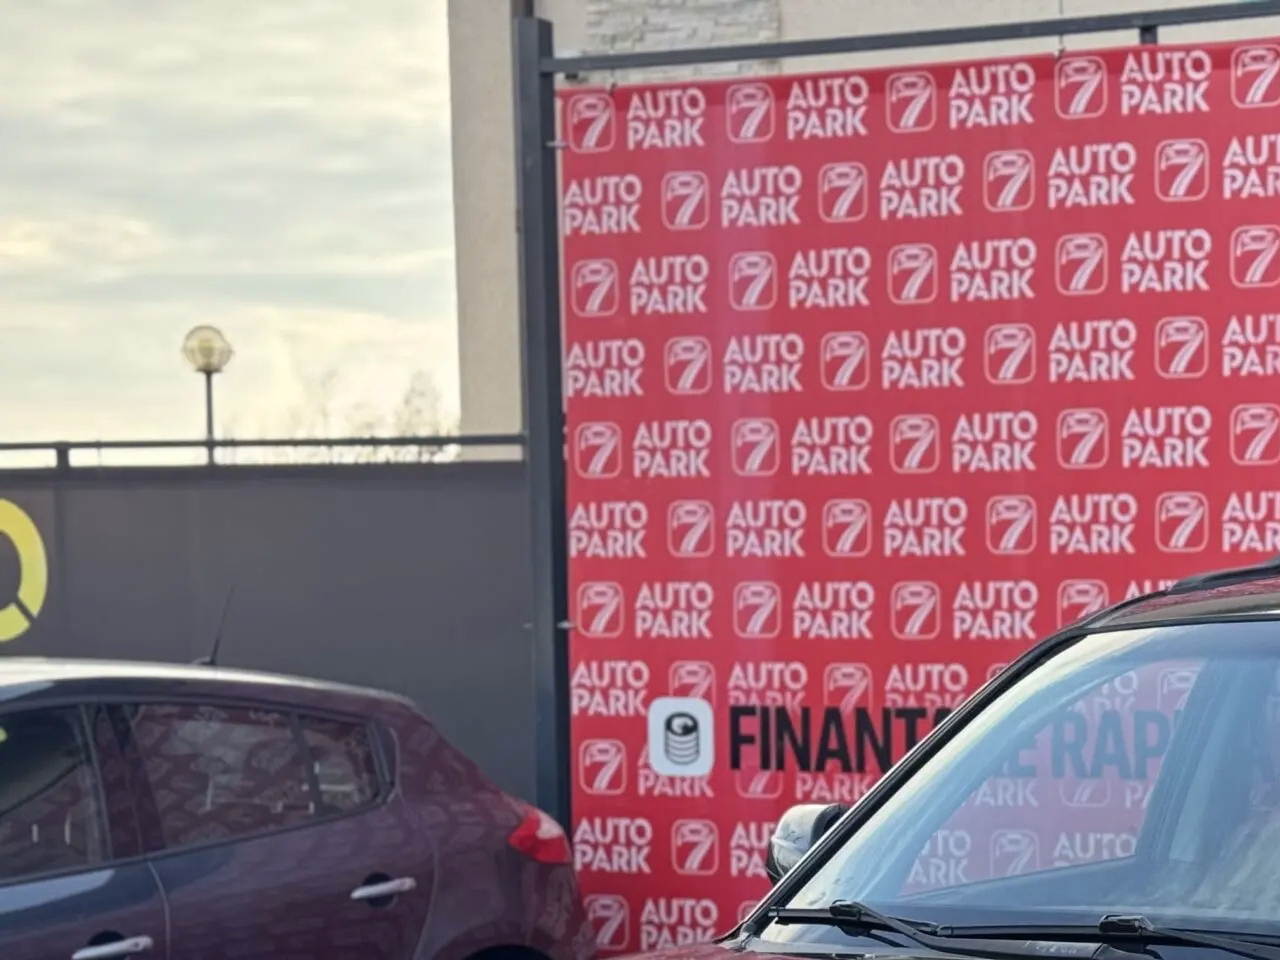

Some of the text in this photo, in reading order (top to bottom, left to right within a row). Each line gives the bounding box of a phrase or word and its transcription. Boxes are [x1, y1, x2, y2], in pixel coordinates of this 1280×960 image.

[948, 63, 1035, 99] AUTO
[1120, 50, 1211, 83] AUTO
[627, 88, 706, 121] AUTO
[786, 76, 868, 111] AUTO
[1121, 80, 1209, 115] PARK
[787, 105, 867, 140] PARK
[950, 92, 1033, 129] PARK
[628, 116, 704, 150] PARK
[880, 155, 964, 191] AUTO
[1048, 142, 1136, 177] AUTO
[564, 175, 642, 206] AUTO
[721, 165, 802, 199] AUTO
[1048, 174, 1134, 208] PARK
[722, 194, 800, 228] PARK
[880, 185, 962, 220] PARK
[564, 205, 640, 234] PARK
[950, 238, 1036, 273] AUTO
[1121, 229, 1211, 261] AUTO
[630, 254, 708, 286] AUTO
[789, 247, 871, 280] AUTO
[1122, 260, 1209, 293] PARK
[631, 284, 706, 314] PARK
[789, 277, 869, 308] PARK
[951, 268, 1034, 302] PARK
[723, 333, 804, 364] AUTO
[882, 327, 966, 361] AUTO
[1049, 319, 1136, 352] AUTO
[566, 338, 645, 369] AUTO
[1050, 350, 1134, 382] PARK
[566, 368, 643, 397] PARK
[724, 362, 802, 393] PARK
[882, 357, 964, 389] PARK
[633, 420, 711, 450] AUTO
[791, 416, 873, 447] AUTO
[952, 411, 1037, 444] AUTO
[1122, 406, 1211, 438] AUTO
[634, 448, 710, 477] PARK
[792, 445, 871, 475] PARK
[953, 441, 1035, 472] PARK
[1122, 437, 1209, 468] PARK
[568, 501, 648, 530] AUTO
[726, 499, 806, 529] AUTO
[884, 497, 967, 528] AUTO
[1050, 493, 1137, 525] AUTO
[569, 529, 646, 559] PARK
[727, 528, 804, 557] PARK
[884, 526, 965, 556] PARK
[1050, 523, 1134, 553] PARK
[635, 581, 713, 610] AUTO
[793, 581, 874, 610] AUTO
[953, 580, 1038, 611] AUTO
[636, 610, 711, 638] PARK
[794, 610, 872, 638] PARK
[954, 610, 1036, 639] PARK
[570, 660, 649, 689] AUTO
[728, 662, 807, 692] AUTO
[886, 663, 968, 692] AUTO
[571, 688, 647, 716] PARK
[573, 817, 652, 846] AUTO
[574, 844, 650, 873] PARK
[641, 897, 718, 925] AUTO
